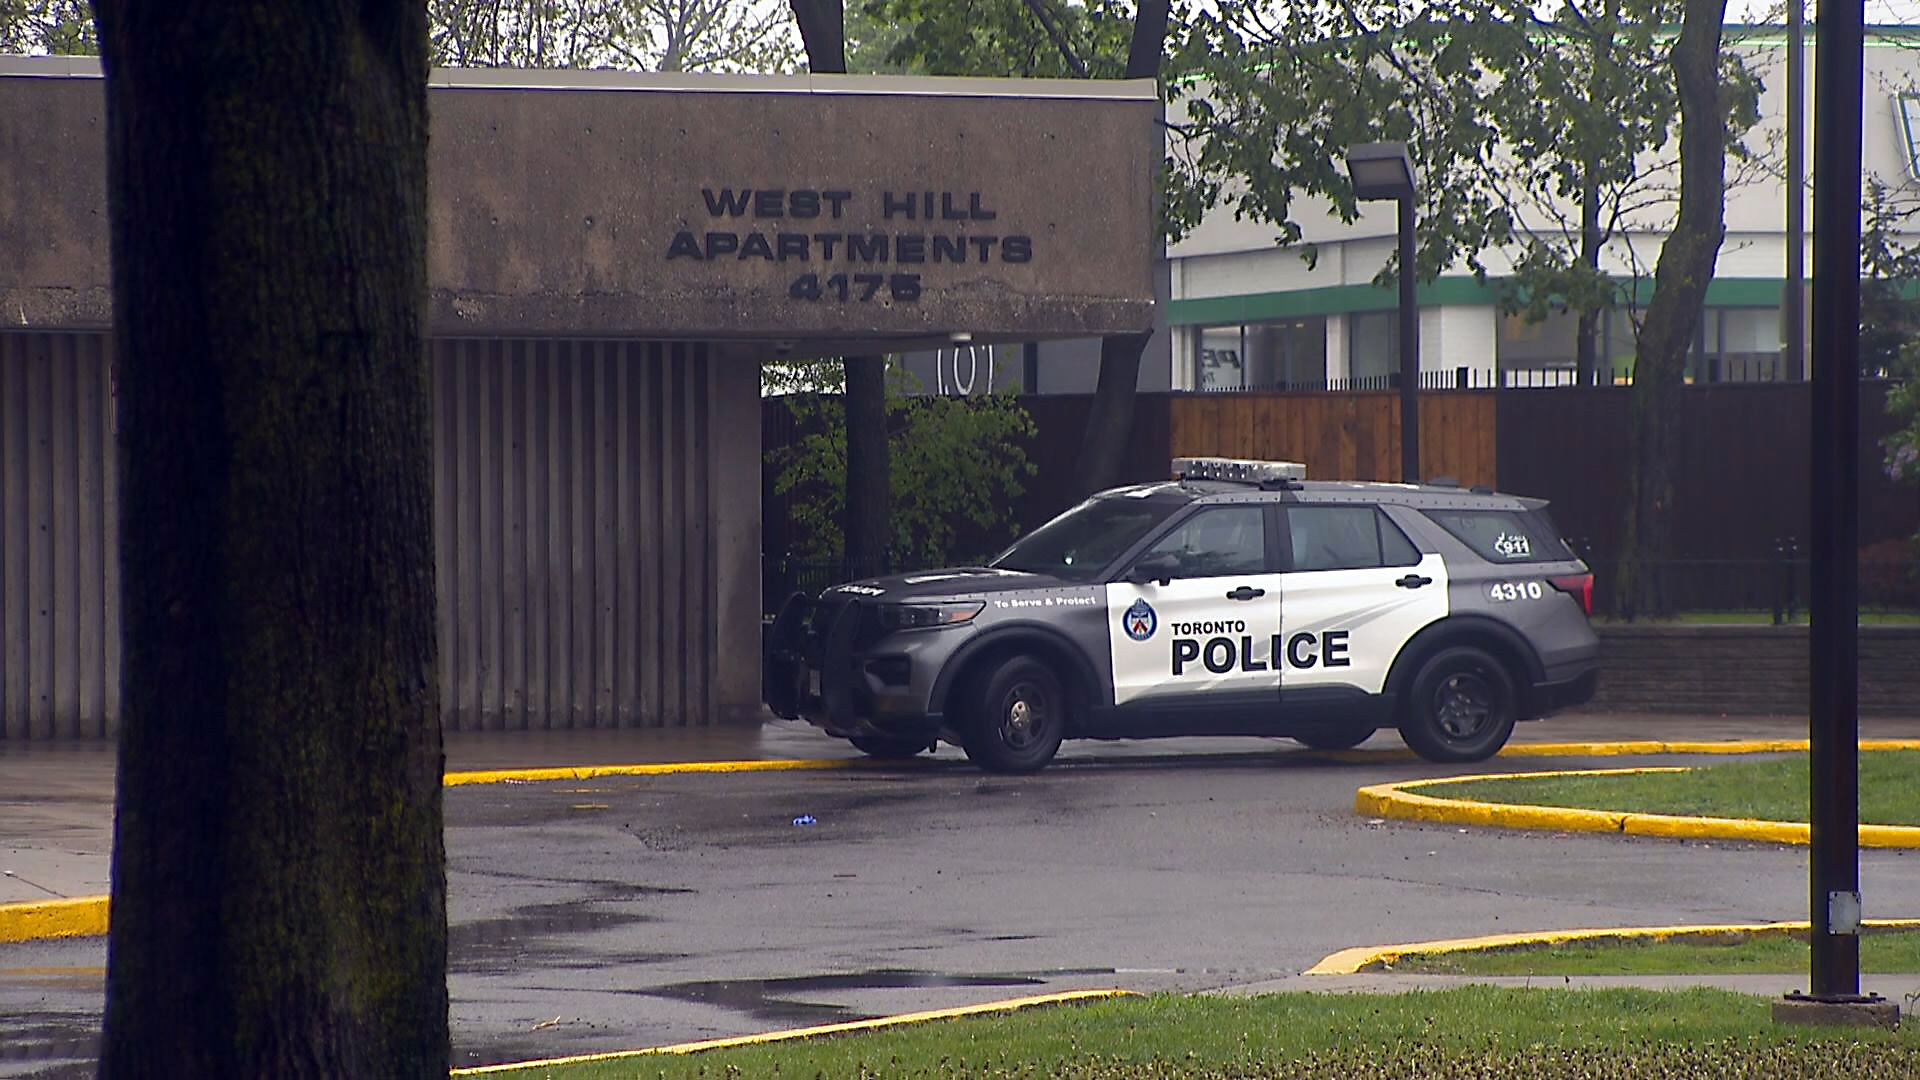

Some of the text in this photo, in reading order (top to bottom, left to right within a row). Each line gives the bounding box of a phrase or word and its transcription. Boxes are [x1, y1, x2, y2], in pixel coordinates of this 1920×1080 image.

[702, 189, 997, 220] WEST HILL
[666, 231, 1033, 263] APARTMENTS
[789, 273, 922, 301] 4175
[1503, 540, 1530, 553] 911
[994, 600, 1008, 608] To
[1056, 596, 1096, 606] Protect
[1490, 581, 1542, 601] 4310
[1171, 620, 1246, 636] TORONTO
[1172, 630, 1351, 676] POLICE
